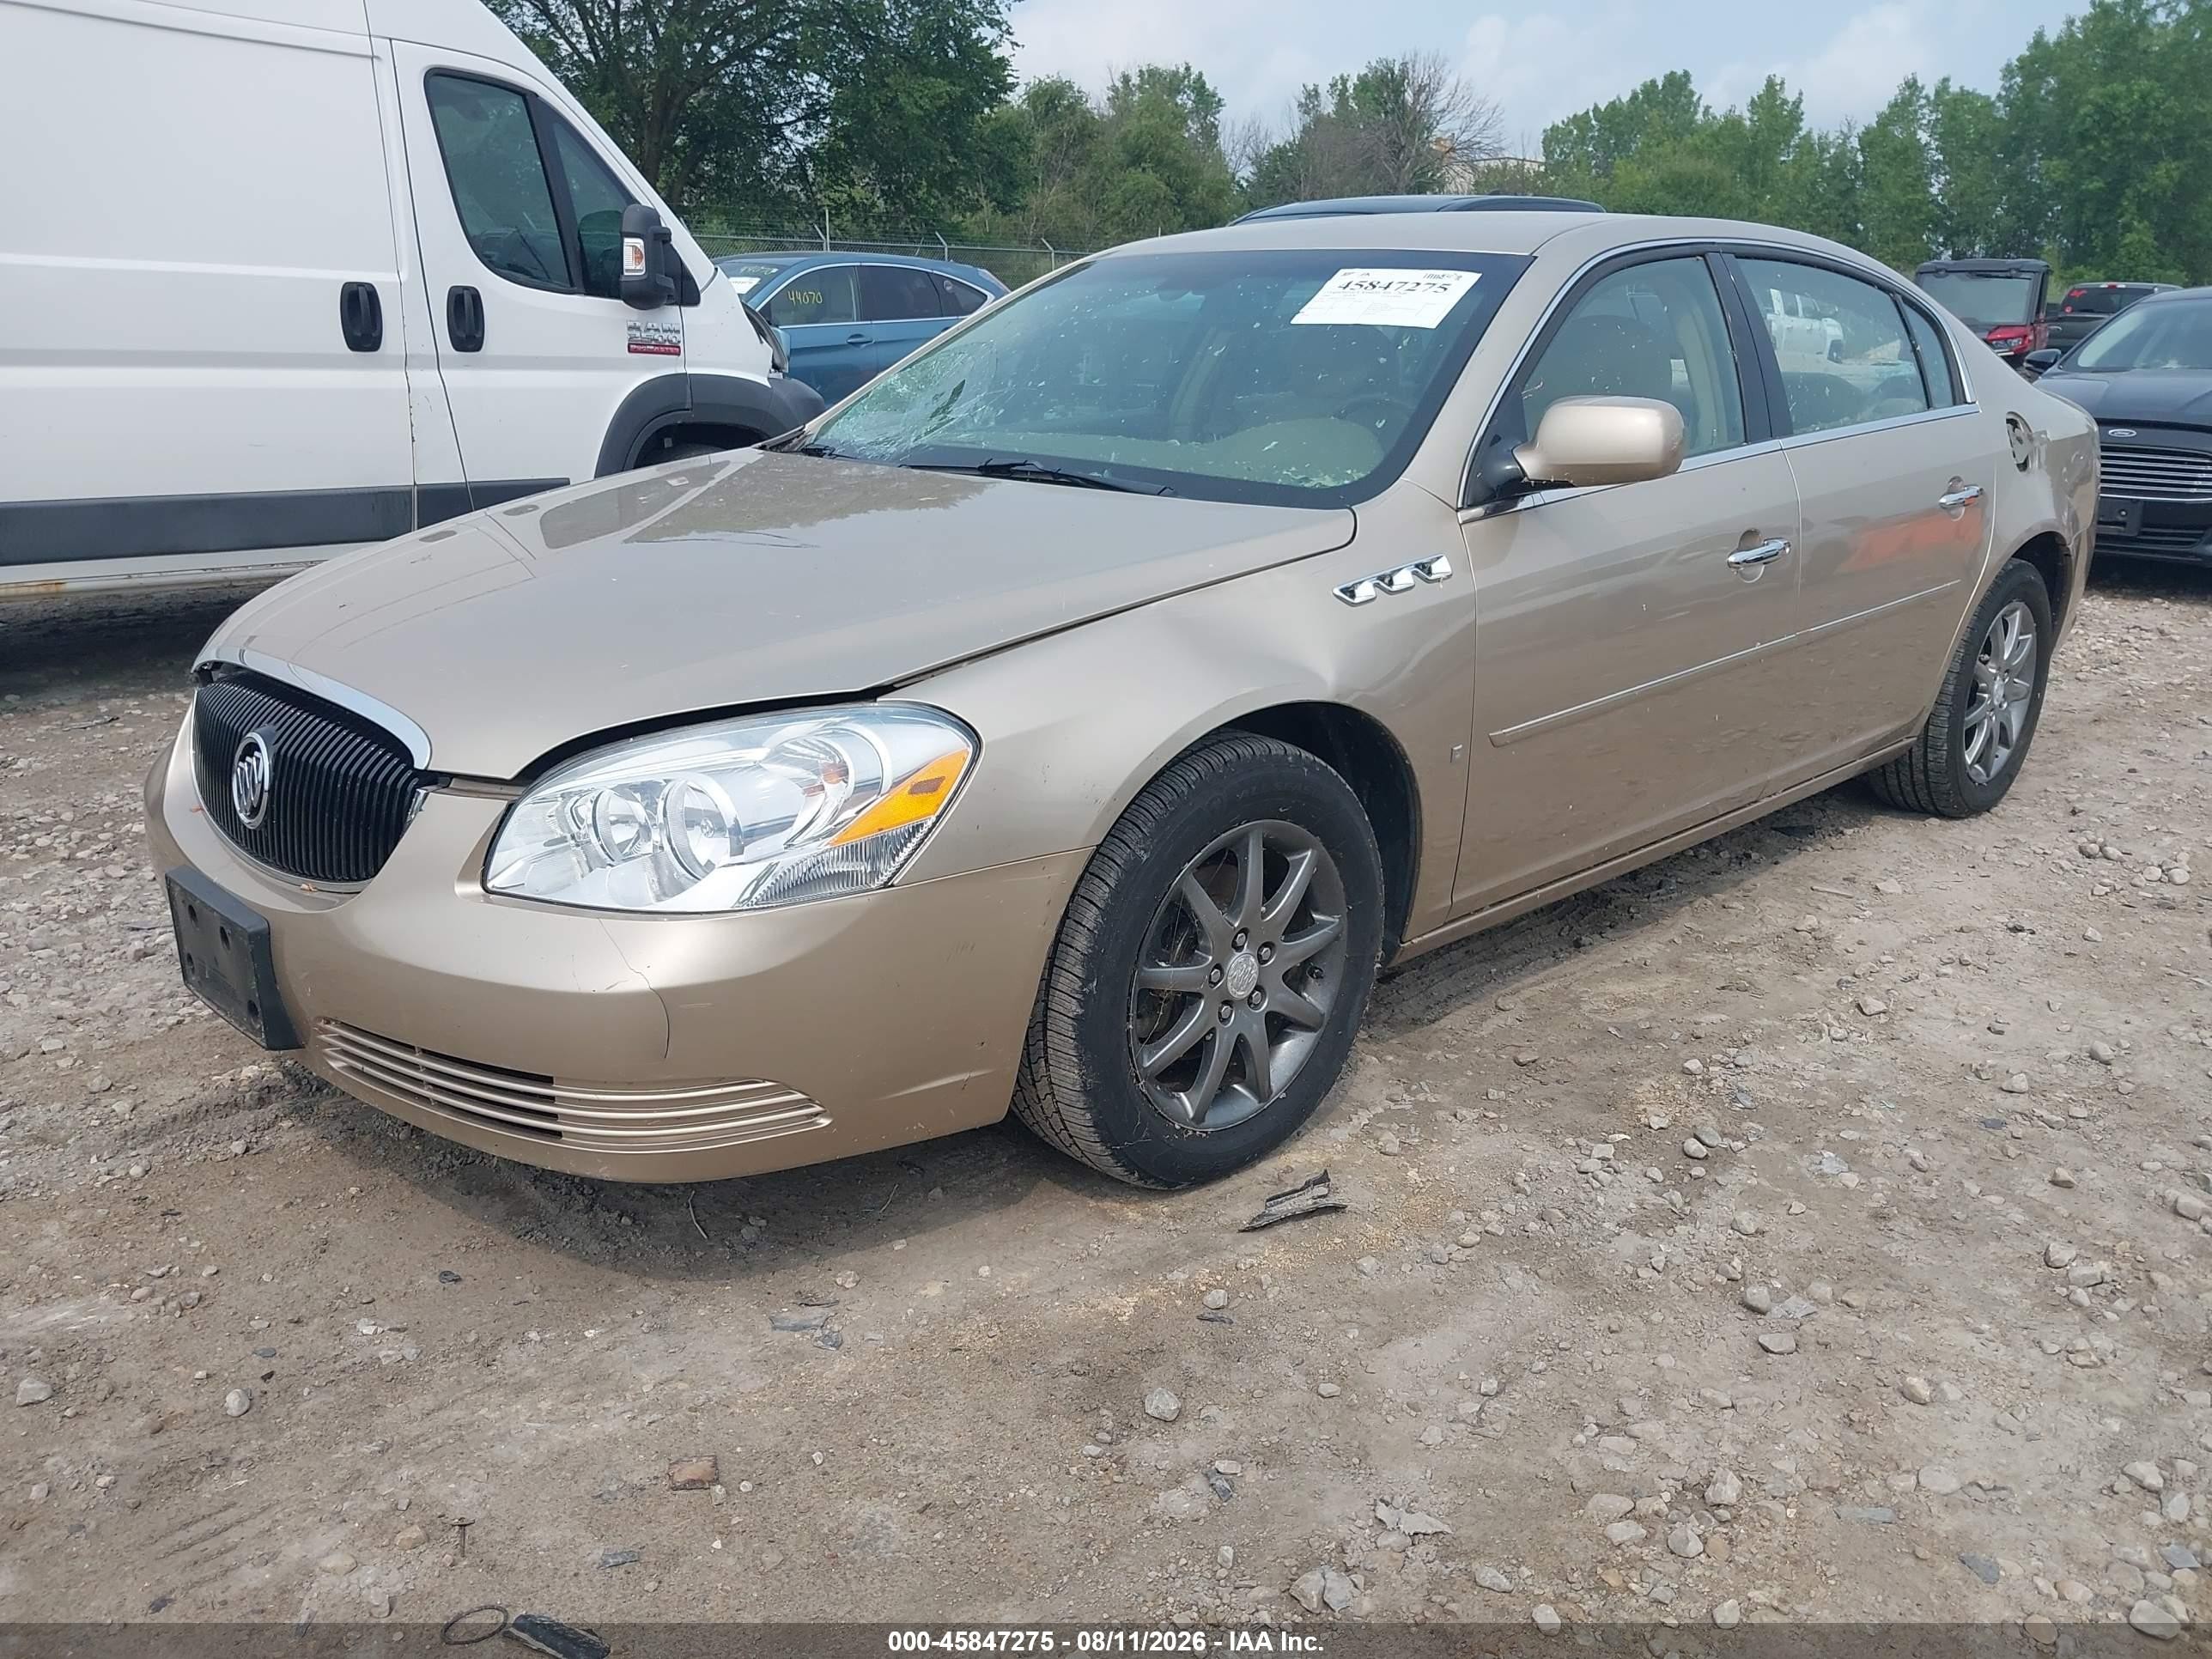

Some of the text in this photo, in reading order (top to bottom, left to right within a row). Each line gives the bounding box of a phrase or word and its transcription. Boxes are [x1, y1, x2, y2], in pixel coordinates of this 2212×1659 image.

[1337, 280, 1453, 294] 45847275
[787, 289, 823, 307] 44070
[627, 321, 681, 334] RAM
